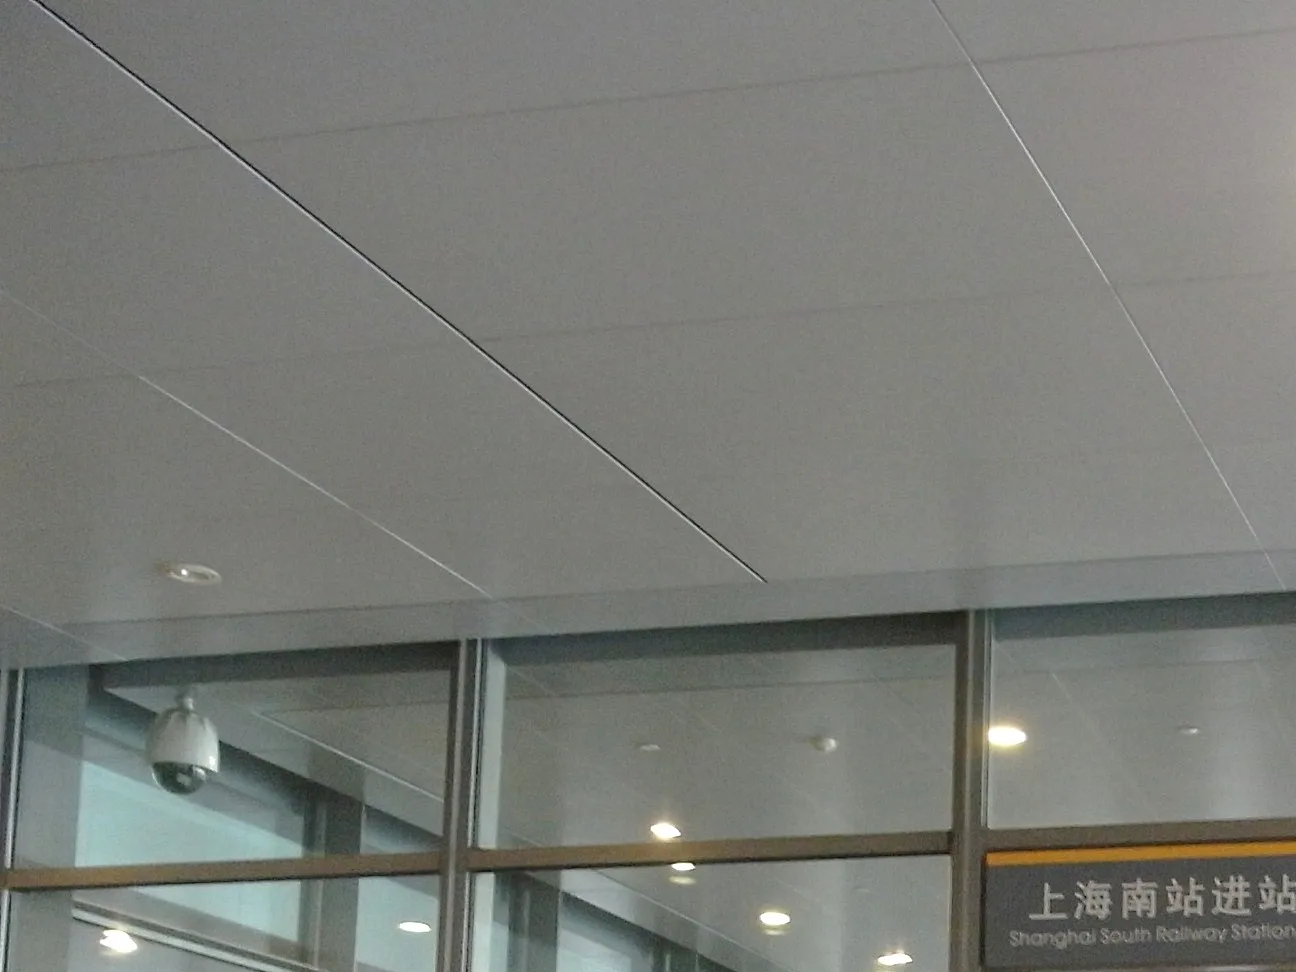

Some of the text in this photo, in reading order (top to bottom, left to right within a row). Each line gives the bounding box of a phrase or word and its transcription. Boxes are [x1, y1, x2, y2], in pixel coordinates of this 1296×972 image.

[1009, 929, 1097, 950] Shanghai
[1100, 927, 1150, 945] South
[1156, 924, 1226, 944] Railway
